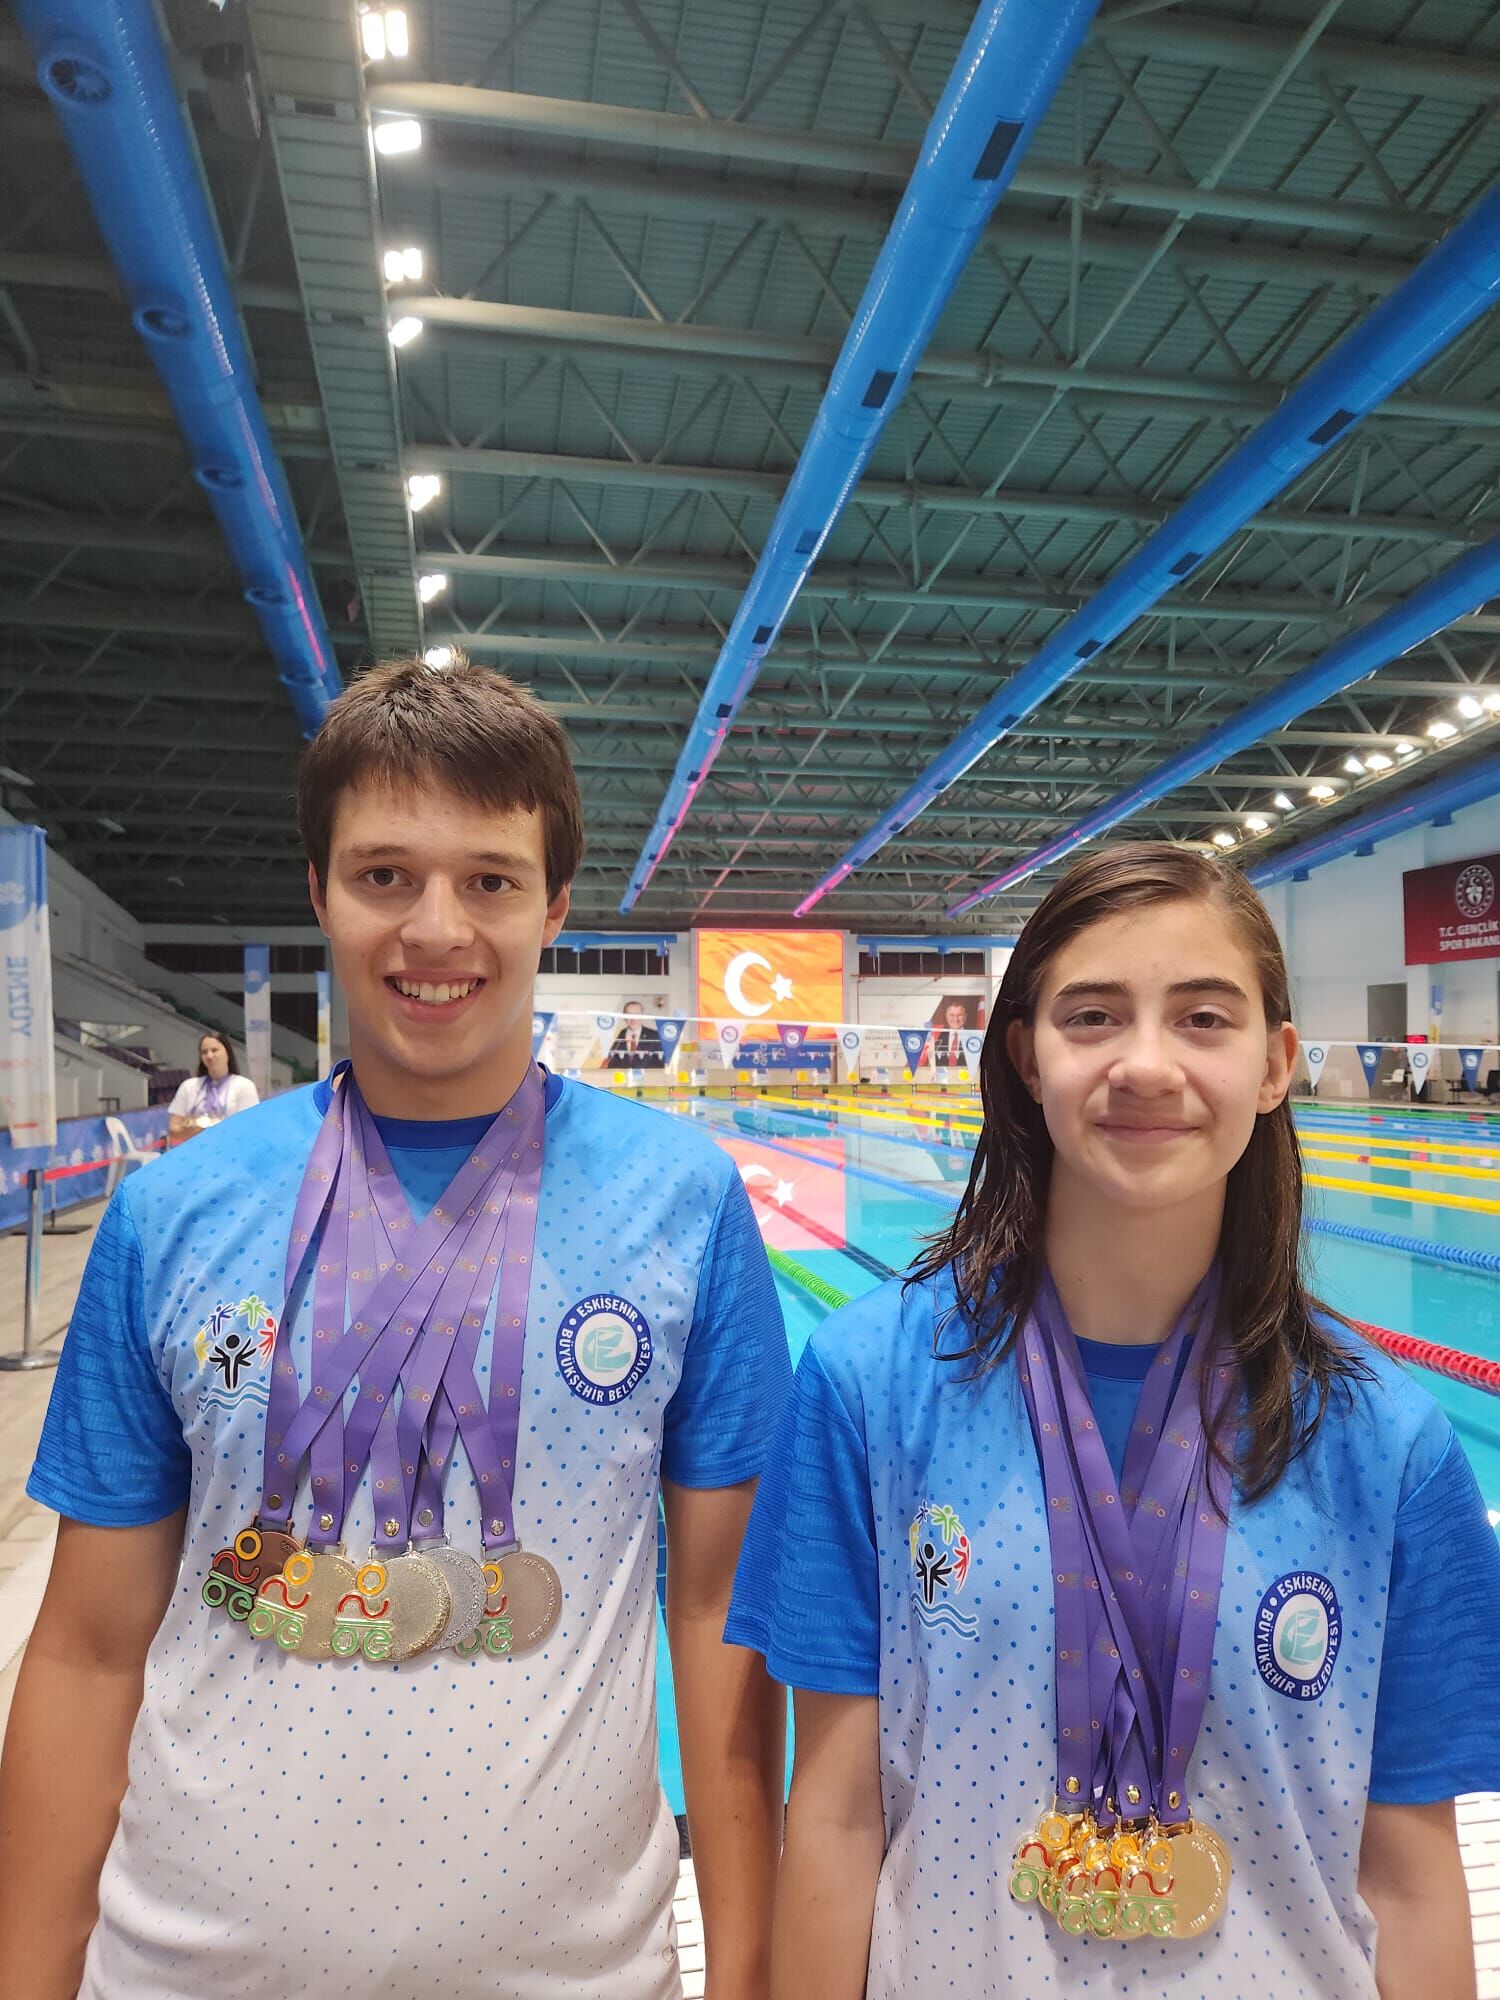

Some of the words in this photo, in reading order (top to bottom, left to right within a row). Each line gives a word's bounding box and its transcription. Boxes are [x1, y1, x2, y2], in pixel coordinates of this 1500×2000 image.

[1439, 938, 1463, 951] SPOR
[576, 1295, 638, 1323] ESKİŞEHİR
[559, 1327, 605, 1402] BÜYÜKŞEHİR
[608, 1336, 651, 1402] BELEDİYESİ
[1276, 1573, 1334, 1605] ESKİŞEHİR
[1256, 1607, 1296, 1694] BÜYÜKŞEHİR
[1301, 1620, 1338, 1697] BELEDİYESİ
